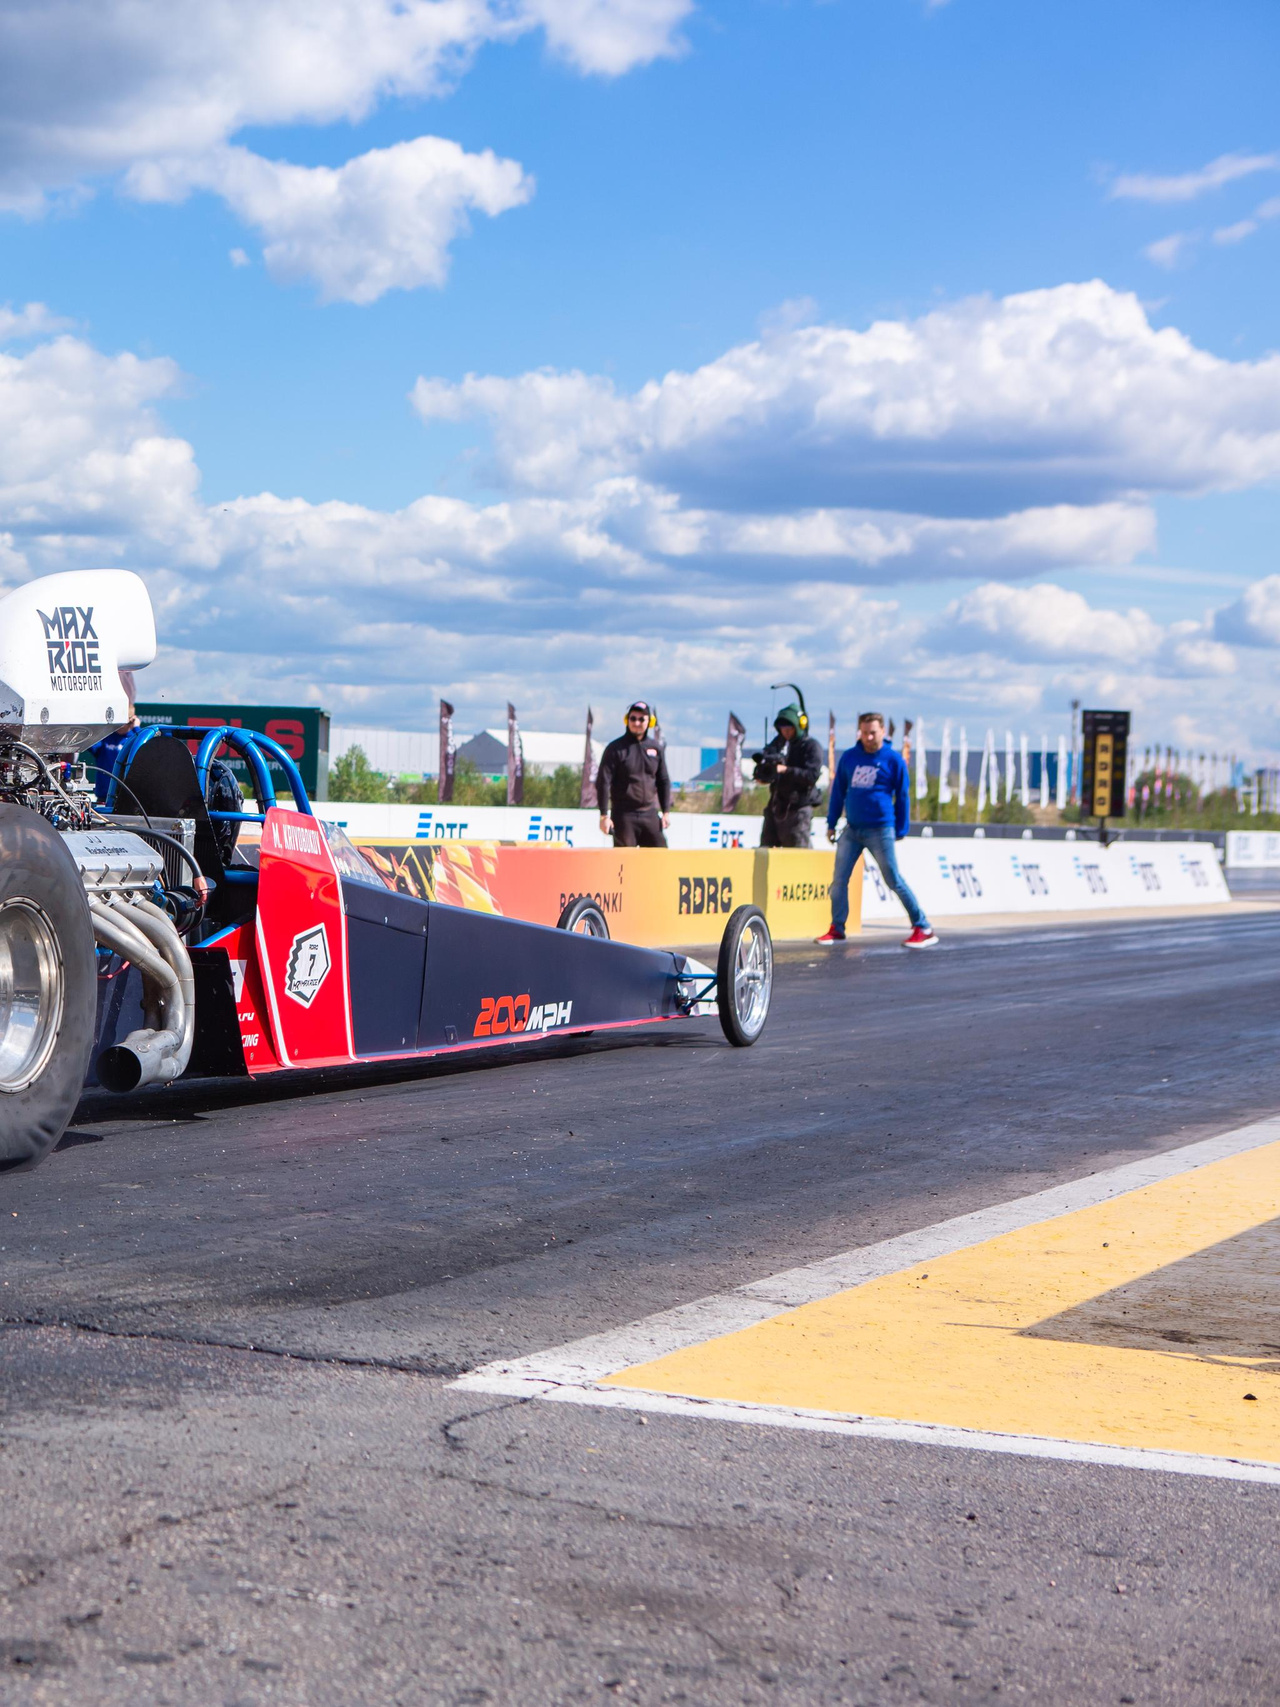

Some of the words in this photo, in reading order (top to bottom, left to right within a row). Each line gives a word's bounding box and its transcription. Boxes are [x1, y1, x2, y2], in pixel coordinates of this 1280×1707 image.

[36, 606, 98, 640] MAX
[50, 675, 102, 691] MOTORSPORT
[272, 822, 283, 849] M.
[308, 954, 317, 977] 7
[473, 994, 530, 1037] 200
[525, 1001, 573, 1033] MPH
[241, 1034, 260, 1048] CING
